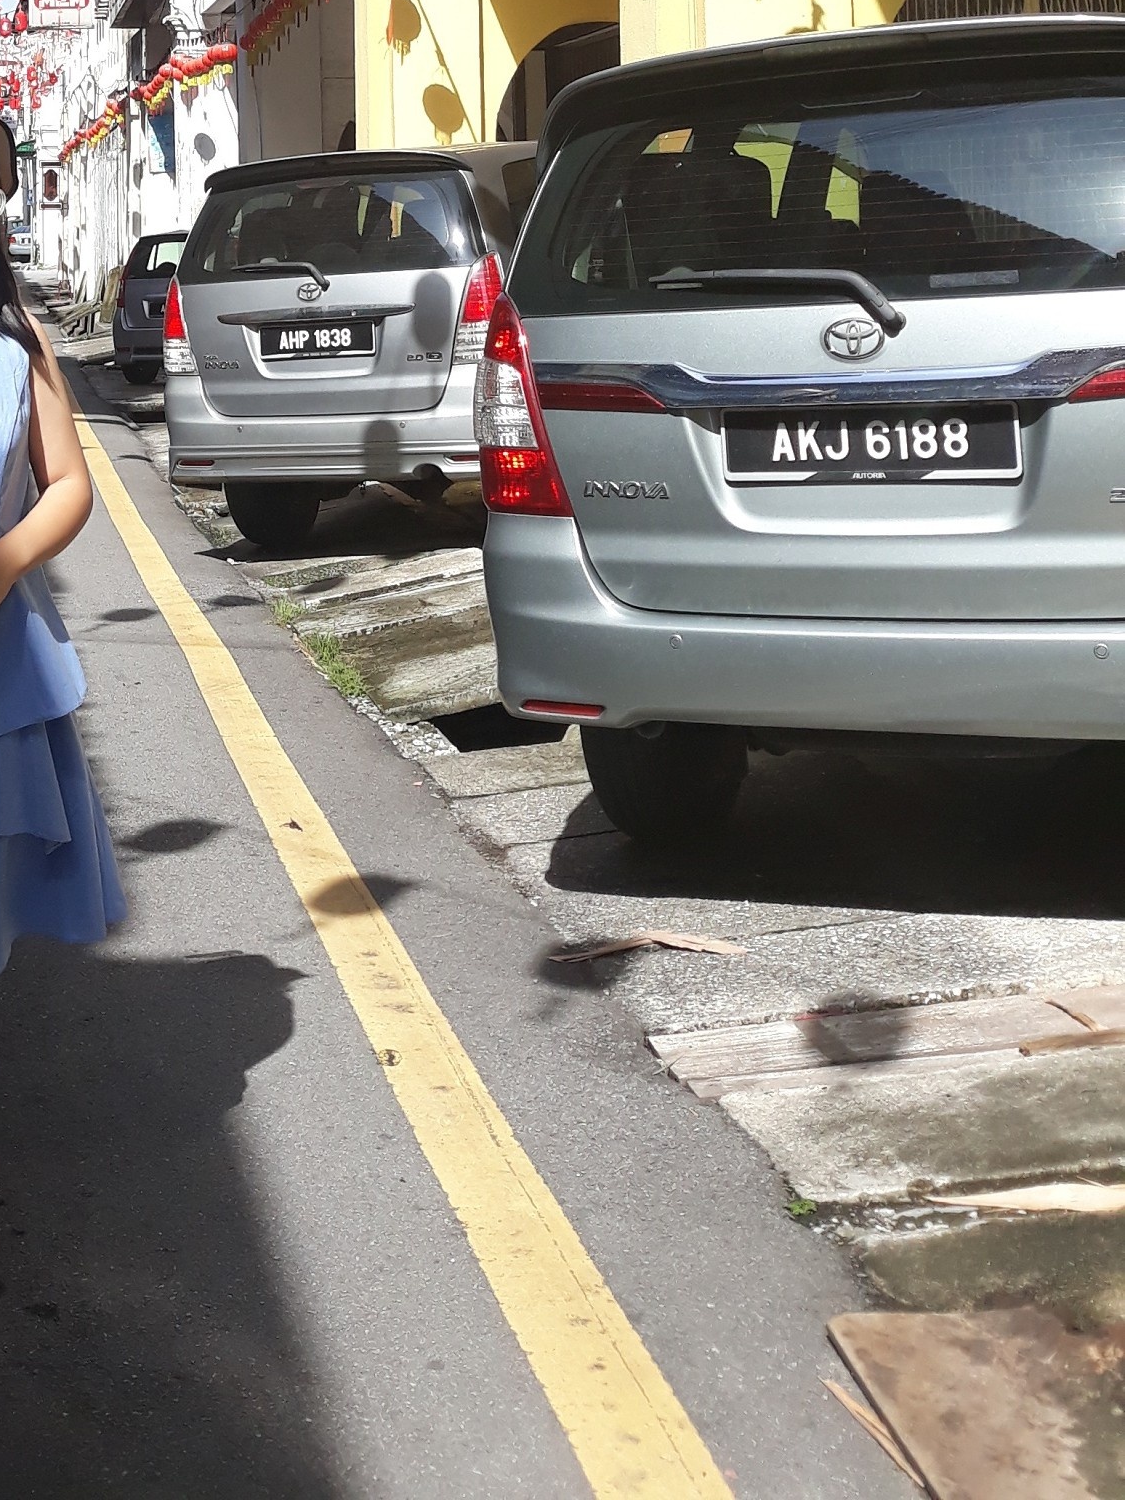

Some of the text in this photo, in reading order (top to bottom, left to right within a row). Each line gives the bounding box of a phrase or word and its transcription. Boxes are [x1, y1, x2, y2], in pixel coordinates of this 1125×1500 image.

[279, 327, 352, 350] AHP 1838
[772, 417, 969, 462] AKJ 6188
[583, 480, 670, 499] INNOVA
